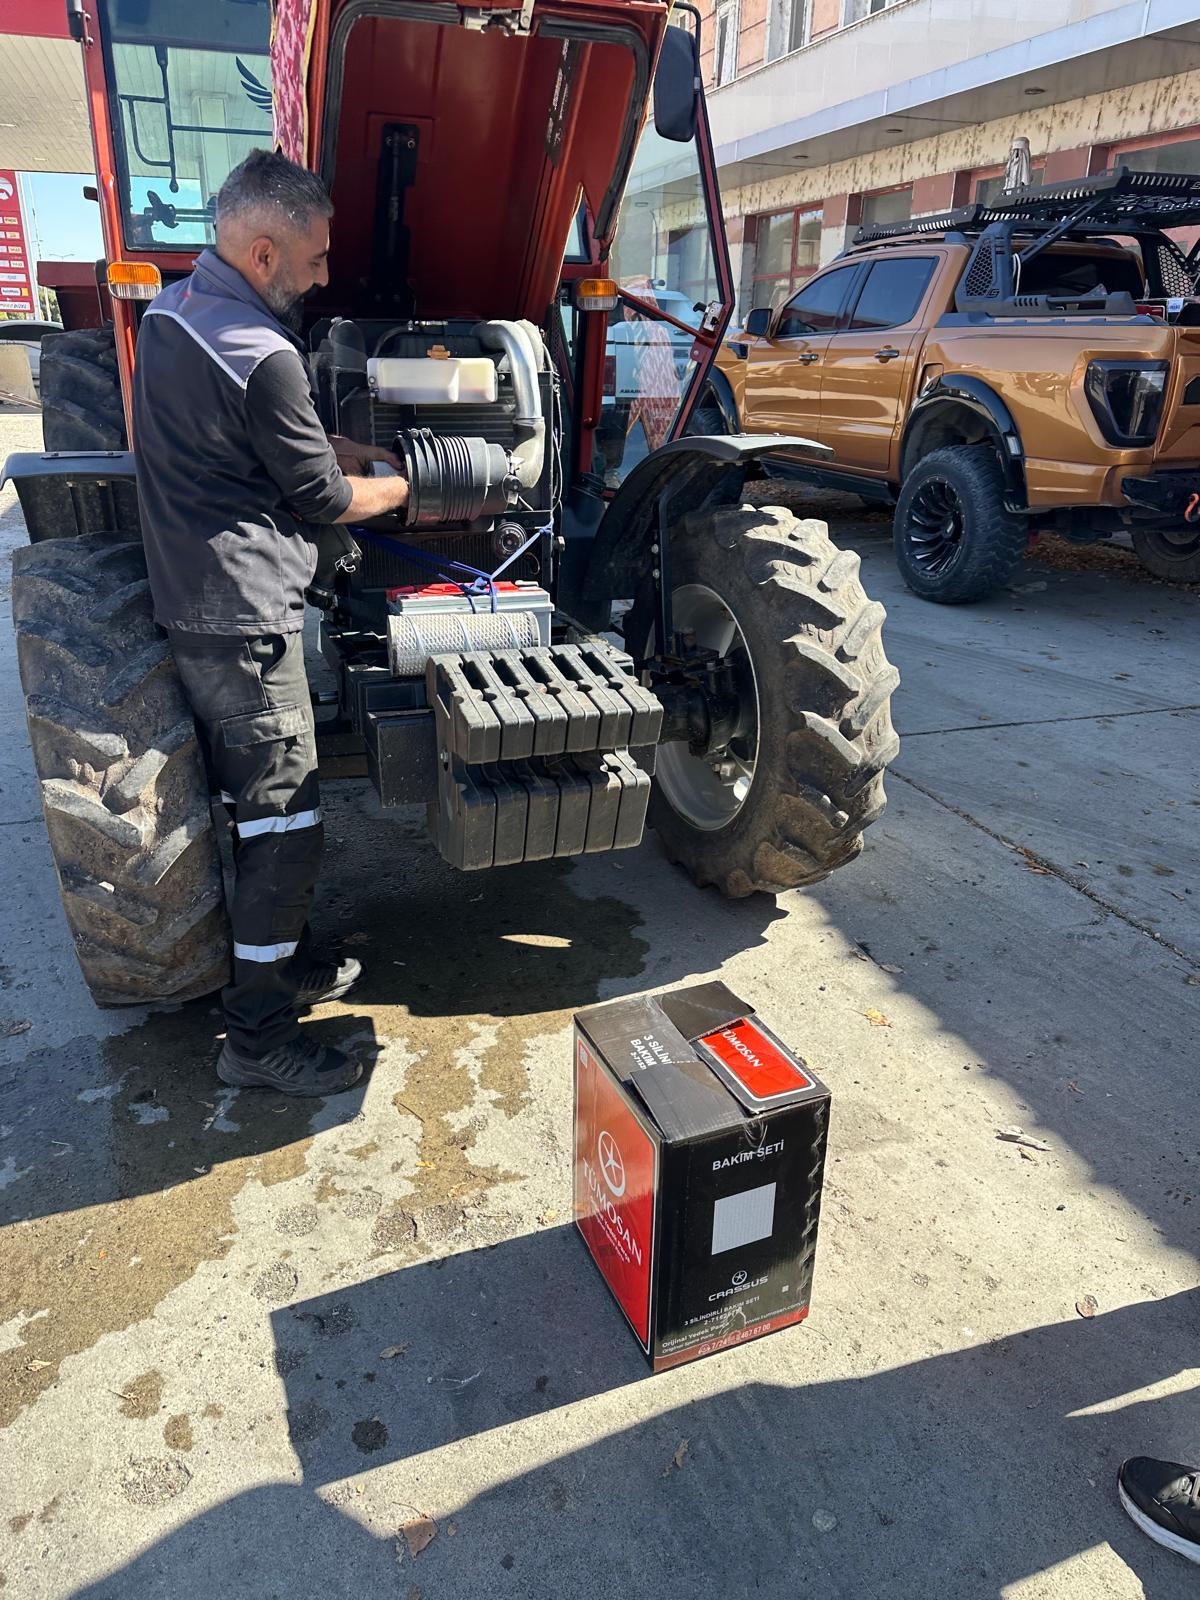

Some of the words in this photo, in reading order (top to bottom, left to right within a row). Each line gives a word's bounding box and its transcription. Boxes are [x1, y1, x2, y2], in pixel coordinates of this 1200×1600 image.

[630, 1038, 657, 1066] BAKIM
[722, 1029, 764, 1068] ÜMOSAN
[712, 1150, 753, 1171] BAKIM
[757, 1139, 784, 1158] SETİ
[582, 1156, 642, 1266] TÜMOSAN
[708, 1275, 769, 1302] CRASSUS
